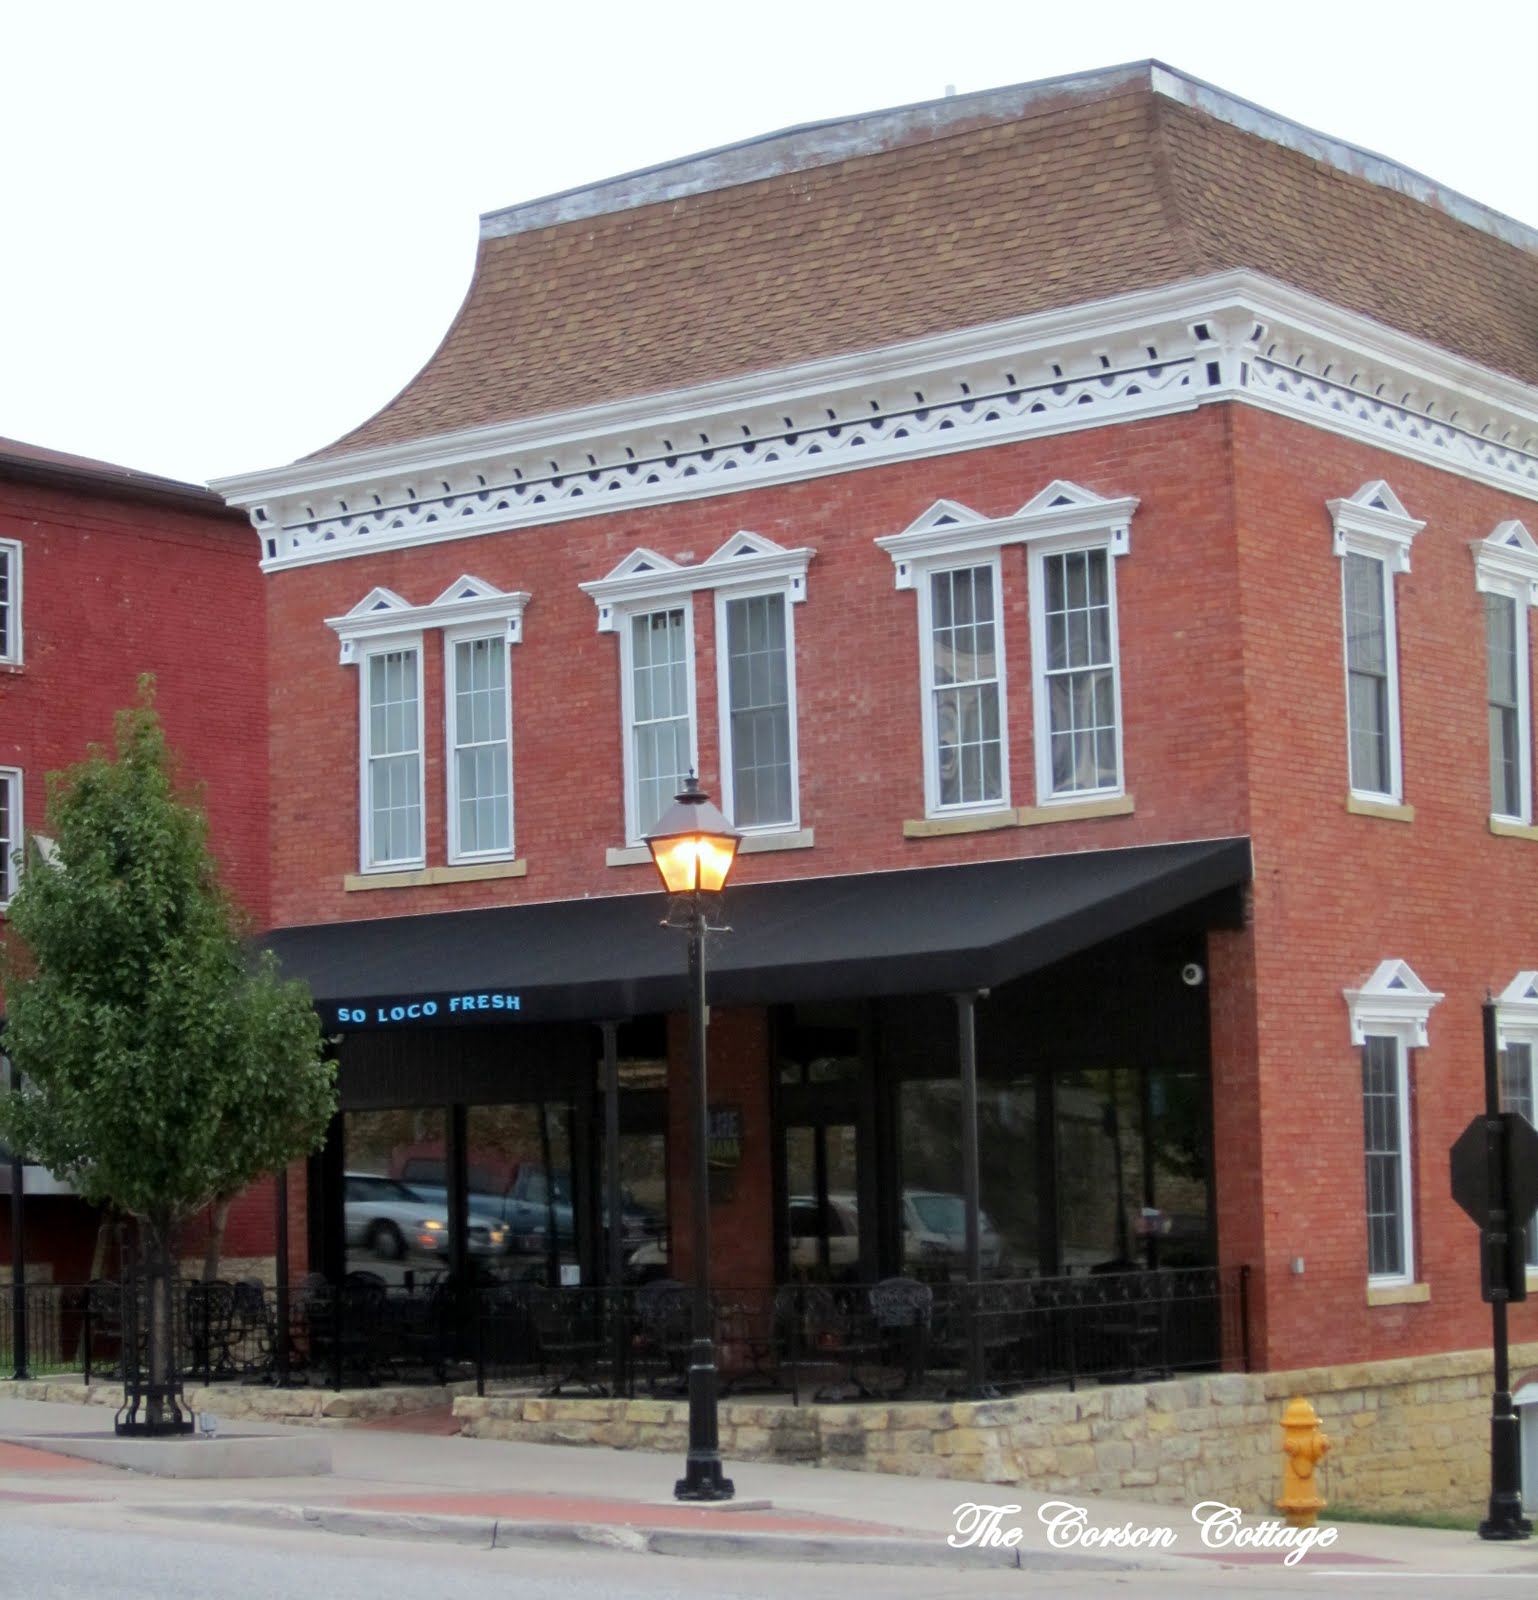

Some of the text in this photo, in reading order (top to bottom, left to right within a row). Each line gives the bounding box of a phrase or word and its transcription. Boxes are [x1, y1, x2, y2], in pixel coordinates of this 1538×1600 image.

[337, 995, 521, 1023] SO LOCO FRESH
